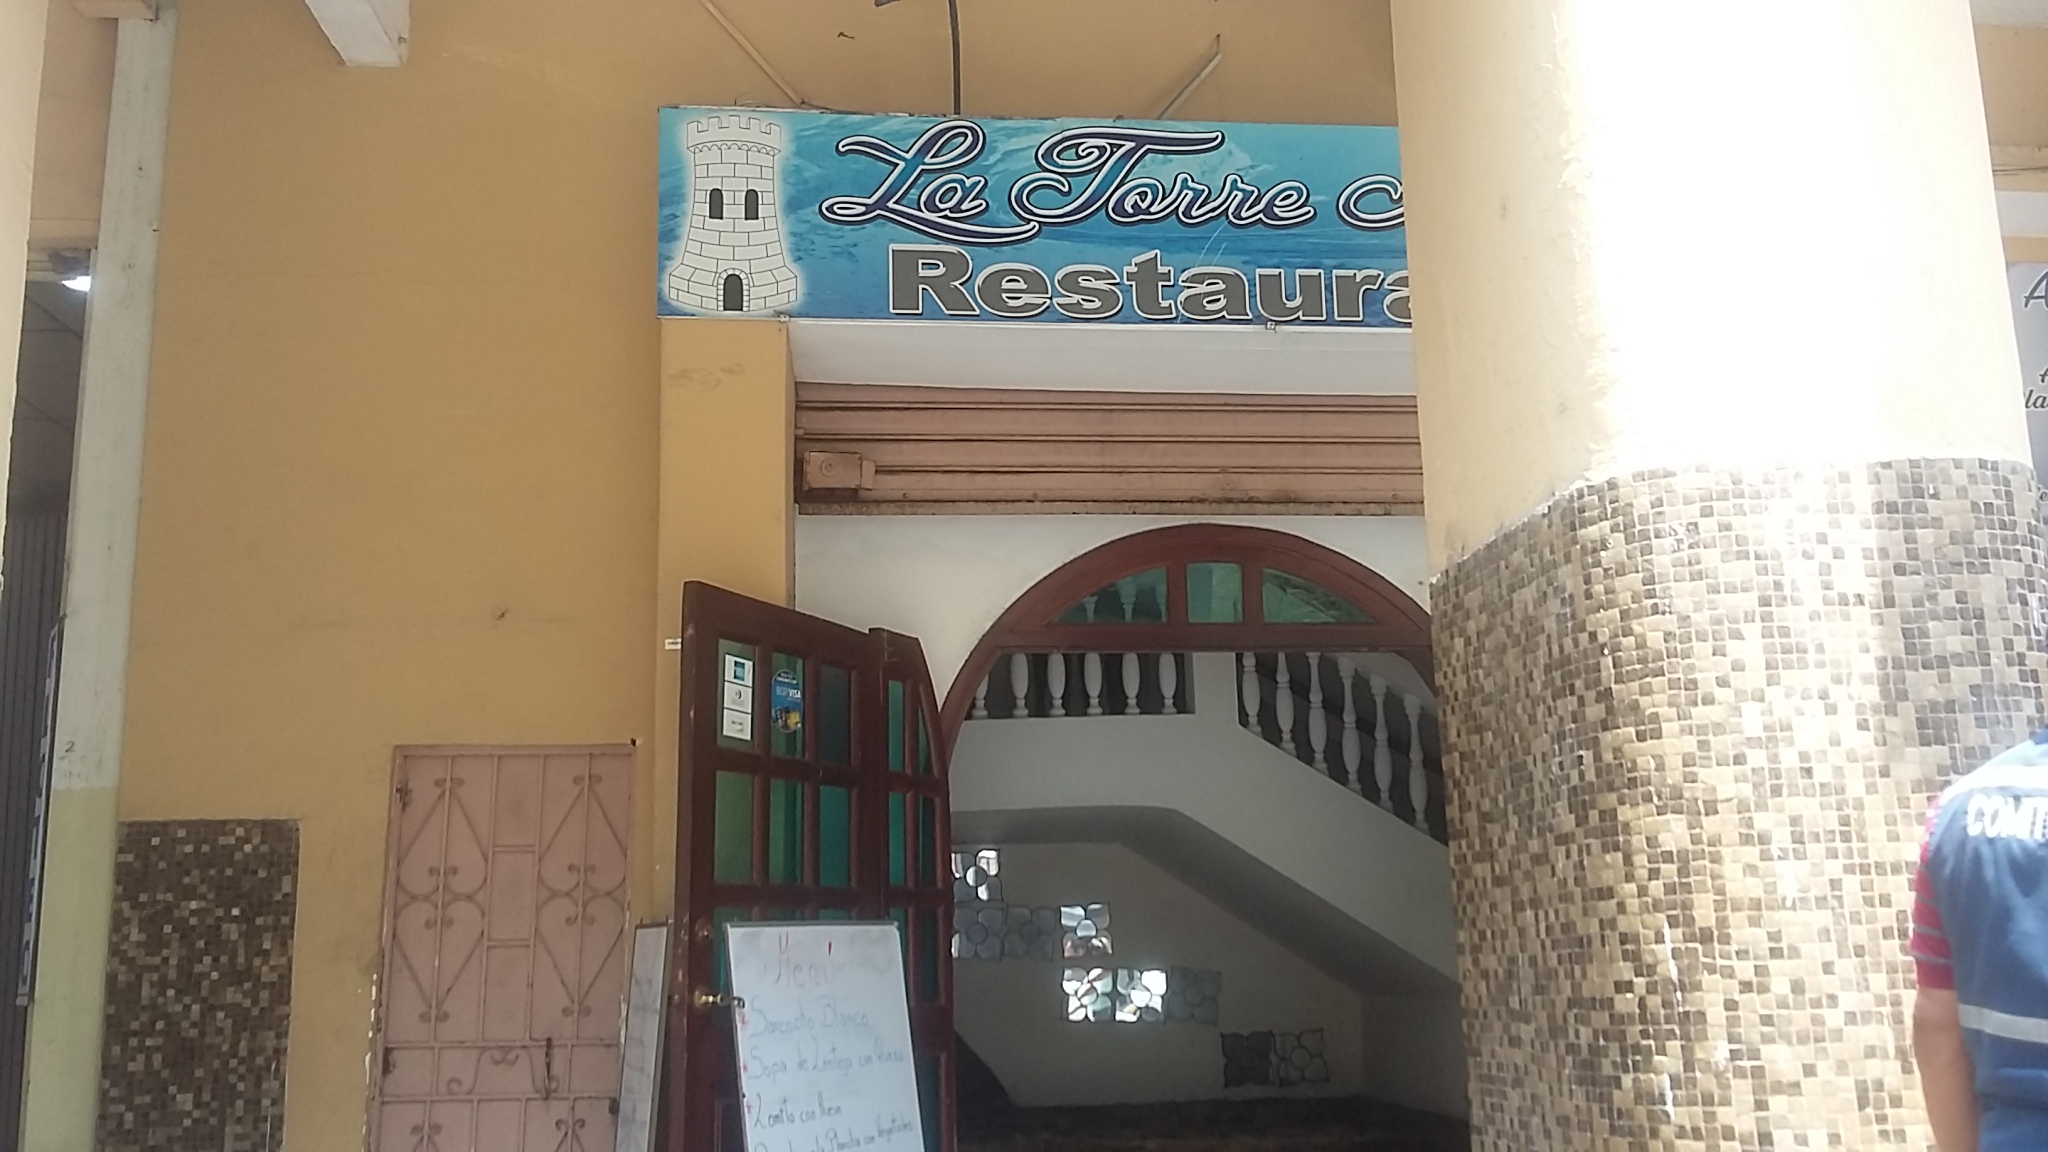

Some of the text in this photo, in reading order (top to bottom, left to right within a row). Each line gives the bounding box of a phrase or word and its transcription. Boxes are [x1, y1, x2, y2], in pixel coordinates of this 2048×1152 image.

[819, 119, 1041, 245] La
[1010, 126, 1316, 228] Torre
[888, 243, 1412, 324] Restaura
